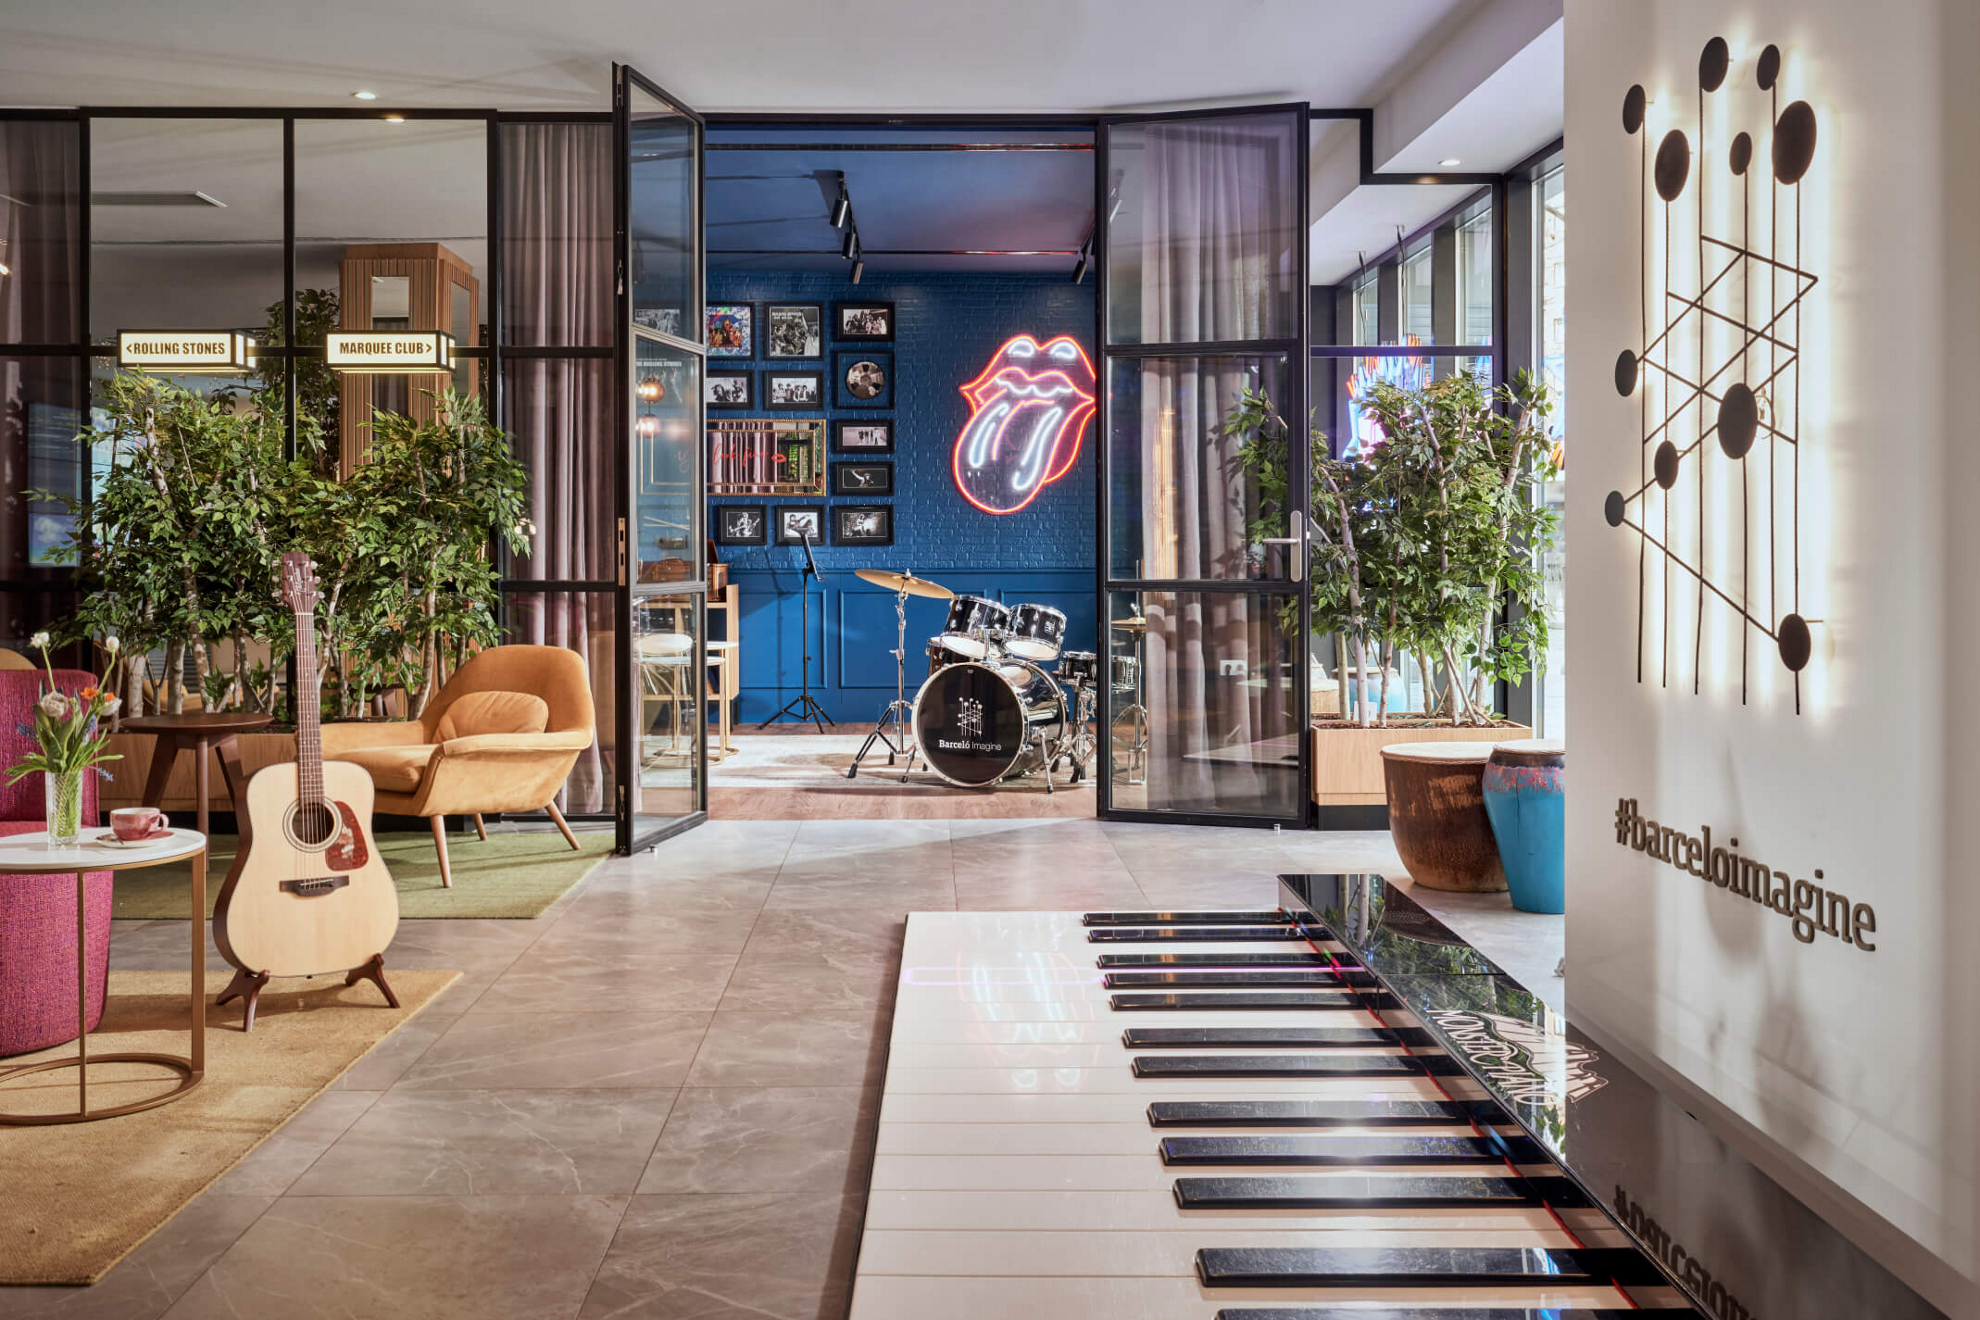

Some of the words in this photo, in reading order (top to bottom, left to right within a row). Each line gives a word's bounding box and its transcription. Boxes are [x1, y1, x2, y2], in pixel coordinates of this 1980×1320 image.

[182, 342, 226, 355] STONES
[340, 342, 393, 356] MARQUEE
[939, 740, 970, 749] Barceló
[1615, 798, 1876, 951] #barceloimagine
[1426, 1009, 1519, 1066] MONSTER
[1482, 1061, 1558, 1106] PIANO
